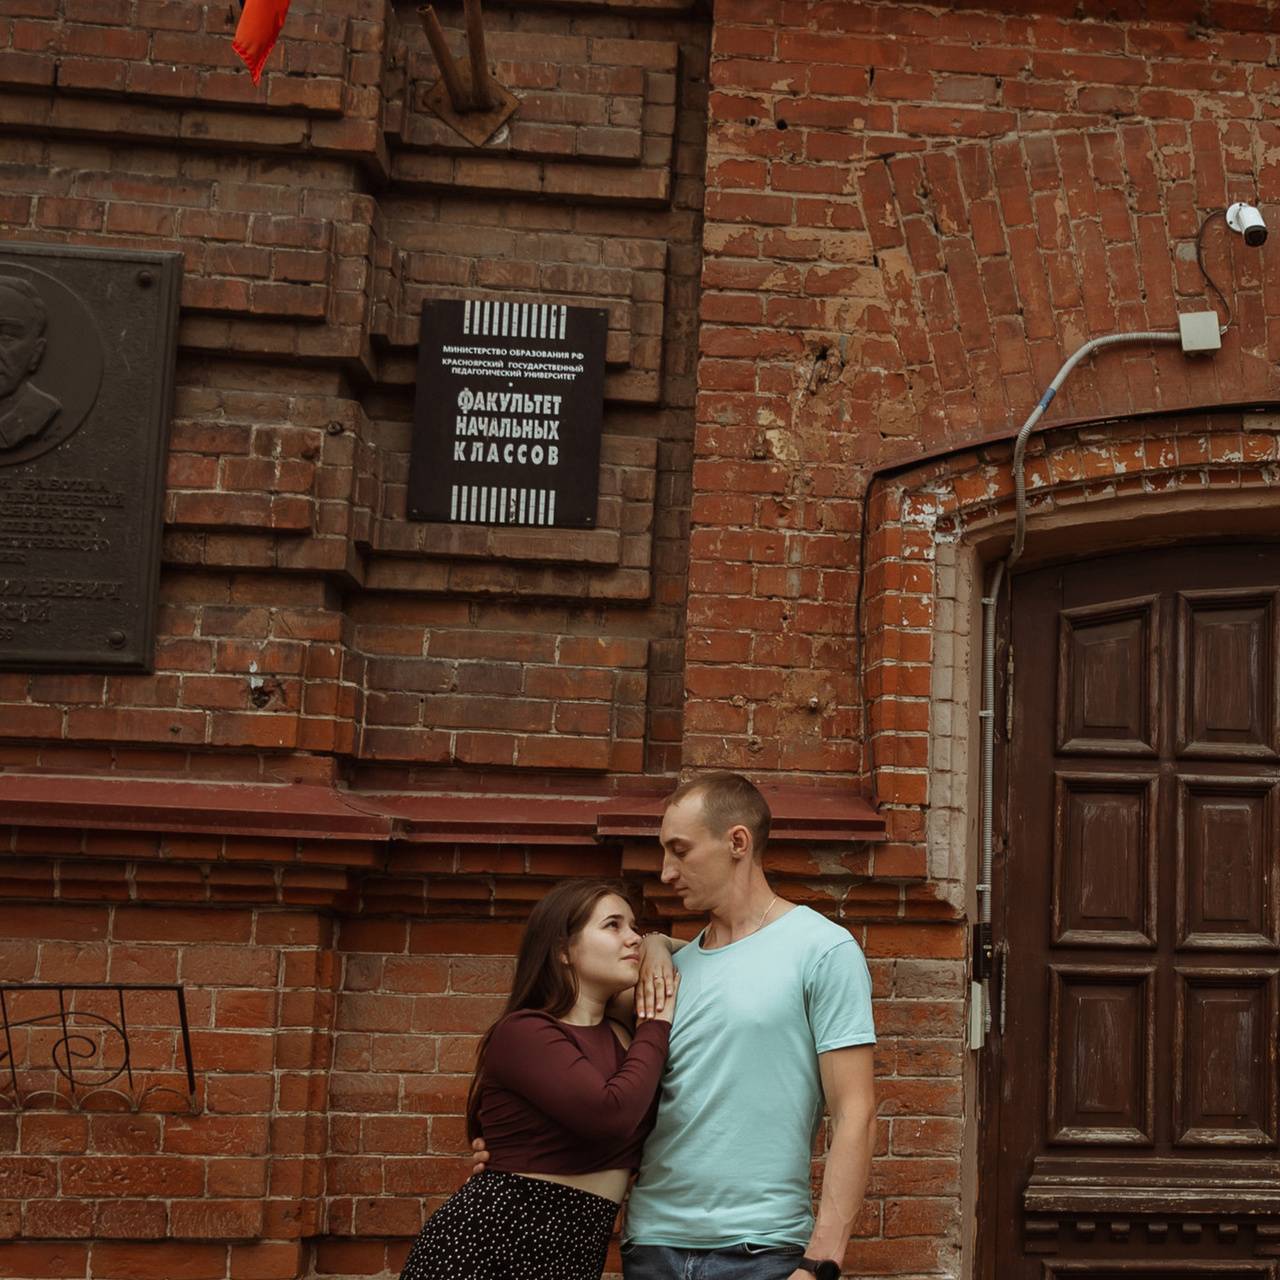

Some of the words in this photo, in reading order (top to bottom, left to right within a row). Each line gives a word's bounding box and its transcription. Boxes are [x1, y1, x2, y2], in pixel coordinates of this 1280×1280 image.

[442, 345, 508, 355] МИНИСТЕРСТВО
[509, 349, 570, 359] ОБРАЗОВАНИЯ
[571, 352, 584, 360] РФ
[442, 358, 504, 368] КРАСНОЯРСКИЙ
[508, 362, 584, 372] ГОСУДАРСТВЕННЫЙ
[451, 367, 522, 378] ПЕДАГОГИЧЕСКИЙ
[524, 372, 576, 380] УНИВЕРСИТЕТ
[457, 387, 563, 415] ФАКУЛЬТЕТ
[455, 415, 560, 441] НАЧАЛЬНЫХ
[453, 441, 560, 466] КЛАССОВ
[23, 477, 110, 493] РАБОТАЛ
[0, 490, 125, 508] ДЕМИЧЕСКОЙ
[0, 505, 105, 523] СНОЯРСКЕ,
[0, 578, 122, 600] ИЛЬЕВИЧ
